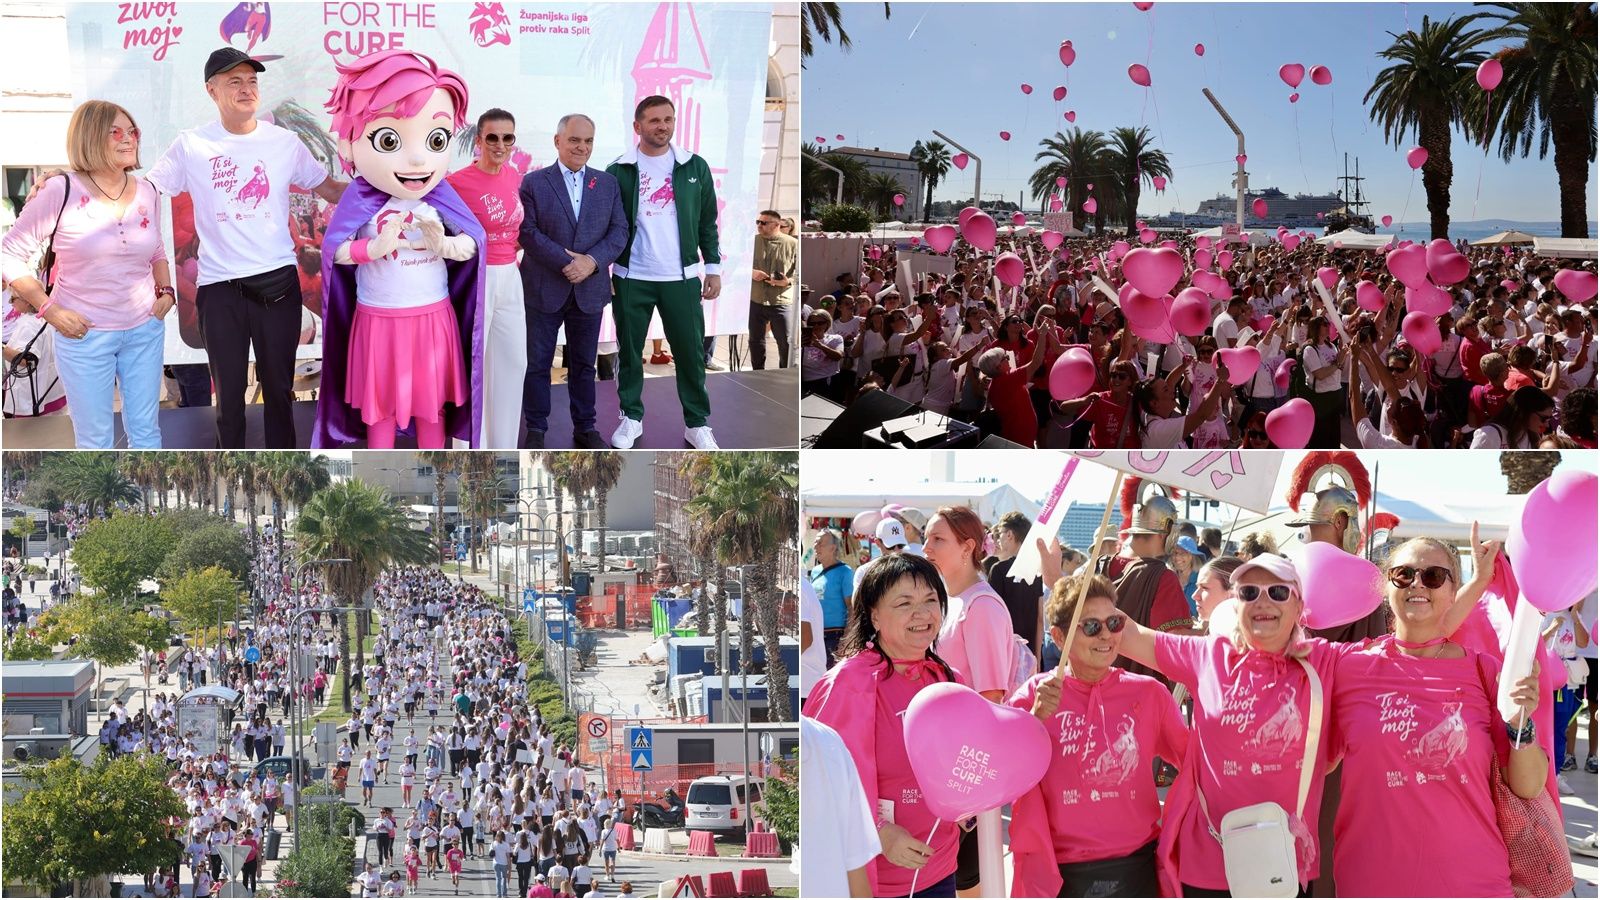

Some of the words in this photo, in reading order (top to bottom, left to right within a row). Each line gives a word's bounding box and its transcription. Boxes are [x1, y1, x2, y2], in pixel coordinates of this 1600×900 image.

[324, 2, 380, 26] FOR
[386, 3, 435, 28] THE
[520, 9, 569, 22] Županijska
[571, 11, 588, 23] liga
[520, 25, 547, 34] protiv
[549, 26, 568, 34] raka
[571, 26, 590, 36] Split
[124, 19, 180, 61] moj
[209, 155, 224, 170] Ti
[223, 157, 232, 168] si
[212, 165, 240, 180] život
[213, 177, 237, 193] moj
[1237, 684, 1251, 697] si
[1375, 691, 1398, 707] Ti
[1396, 694, 1410, 705] si
[1055, 711, 1075, 730] Ti
[1075, 714, 1086, 726] si
[1379, 703, 1421, 721] život
[1220, 710, 1255, 733] moj
[1381, 718, 1416, 741] moj
[1059, 724, 1098, 743] živt
[960, 745, 990, 765] RACE
[1062, 738, 1095, 762] mj
[955, 756, 978, 772] FOR
[979, 764, 998, 780] THE
[946, 779, 973, 795] SPLIT
